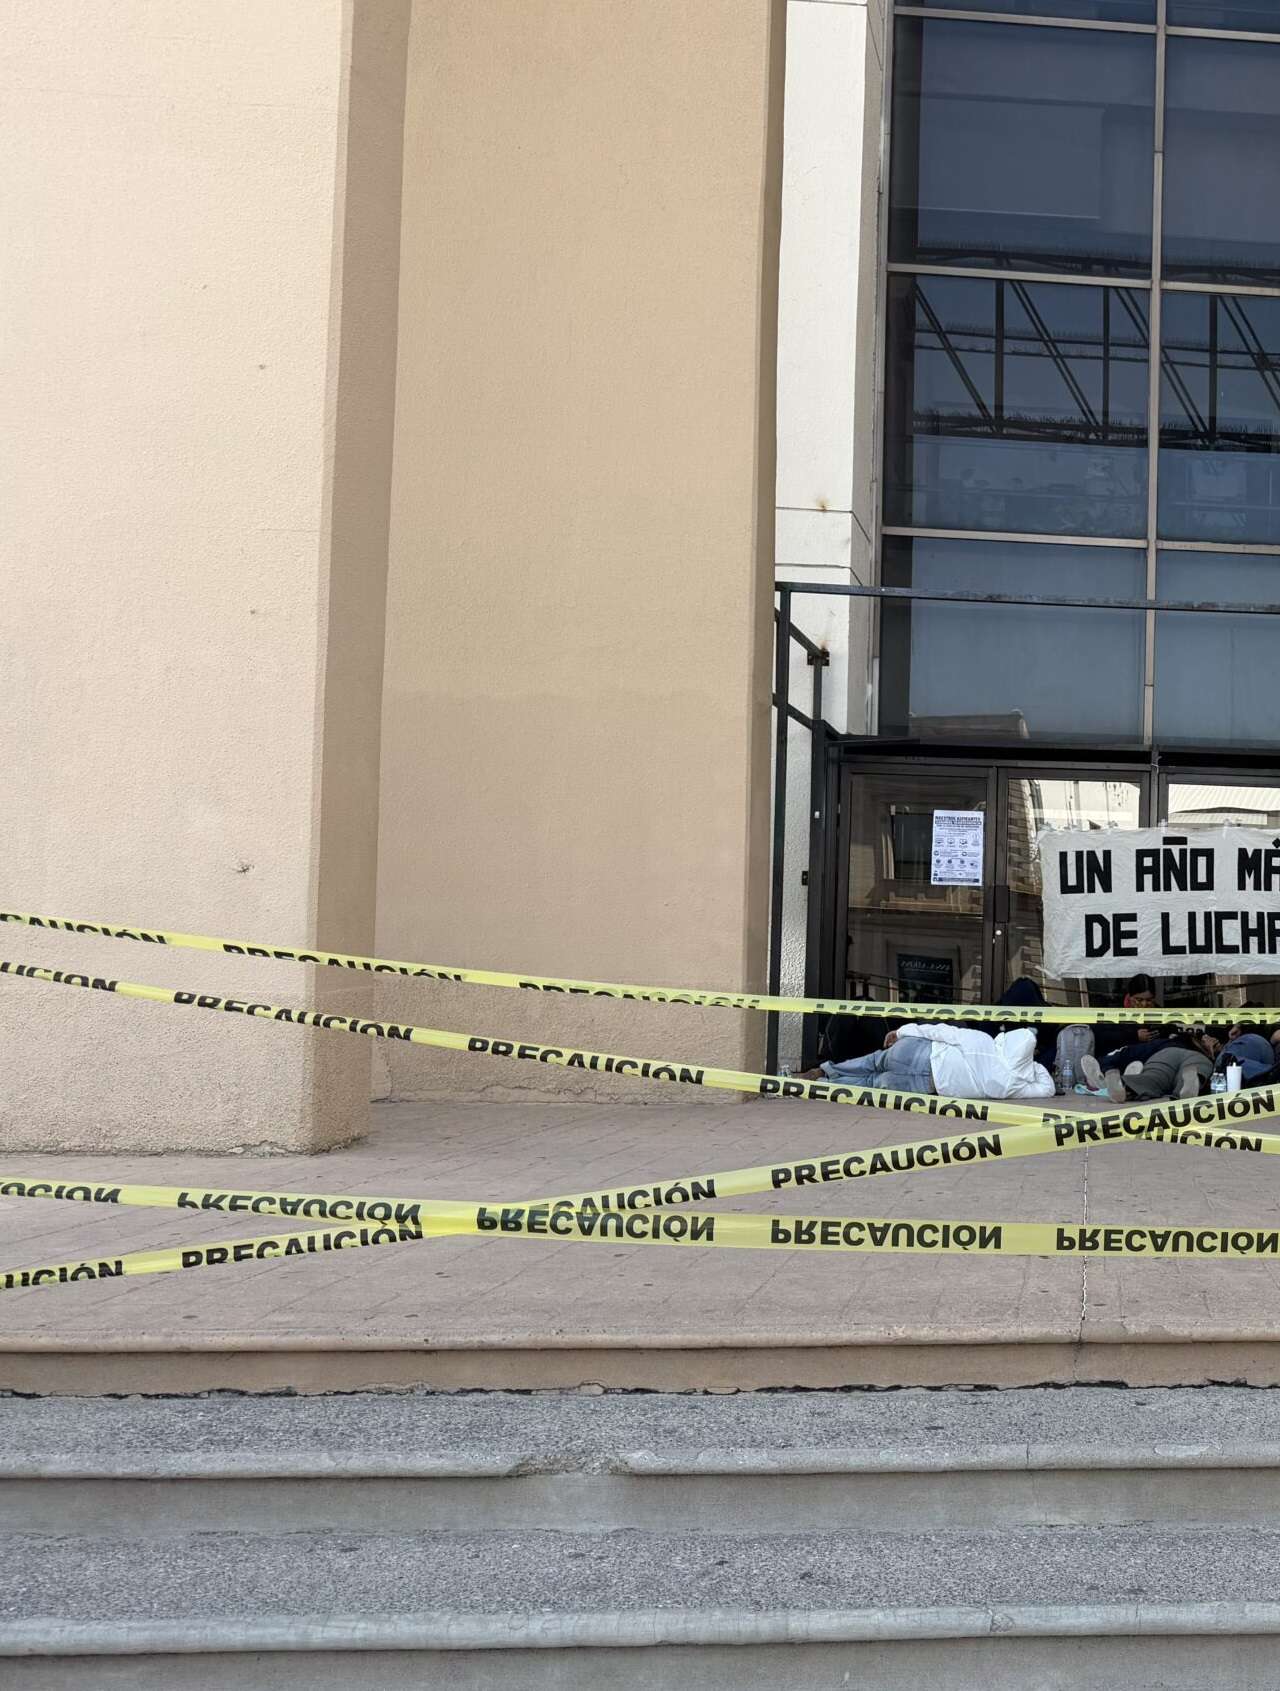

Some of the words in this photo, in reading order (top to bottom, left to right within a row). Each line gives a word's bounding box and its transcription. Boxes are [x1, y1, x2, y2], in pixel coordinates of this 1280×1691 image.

[1059, 850, 1112, 894] UN
[1136, 836, 1215, 893] AÑO
[1085, 912, 1138, 957] DE
[468, 1036, 704, 1085] PRECAUCIÓN
[759, 1078, 989, 1121] PRECAUCIÓN
[771, 1134, 1003, 1189] PRECAUCIÓN
[1054, 1089, 1276, 1147] PRECAUCIÓN
